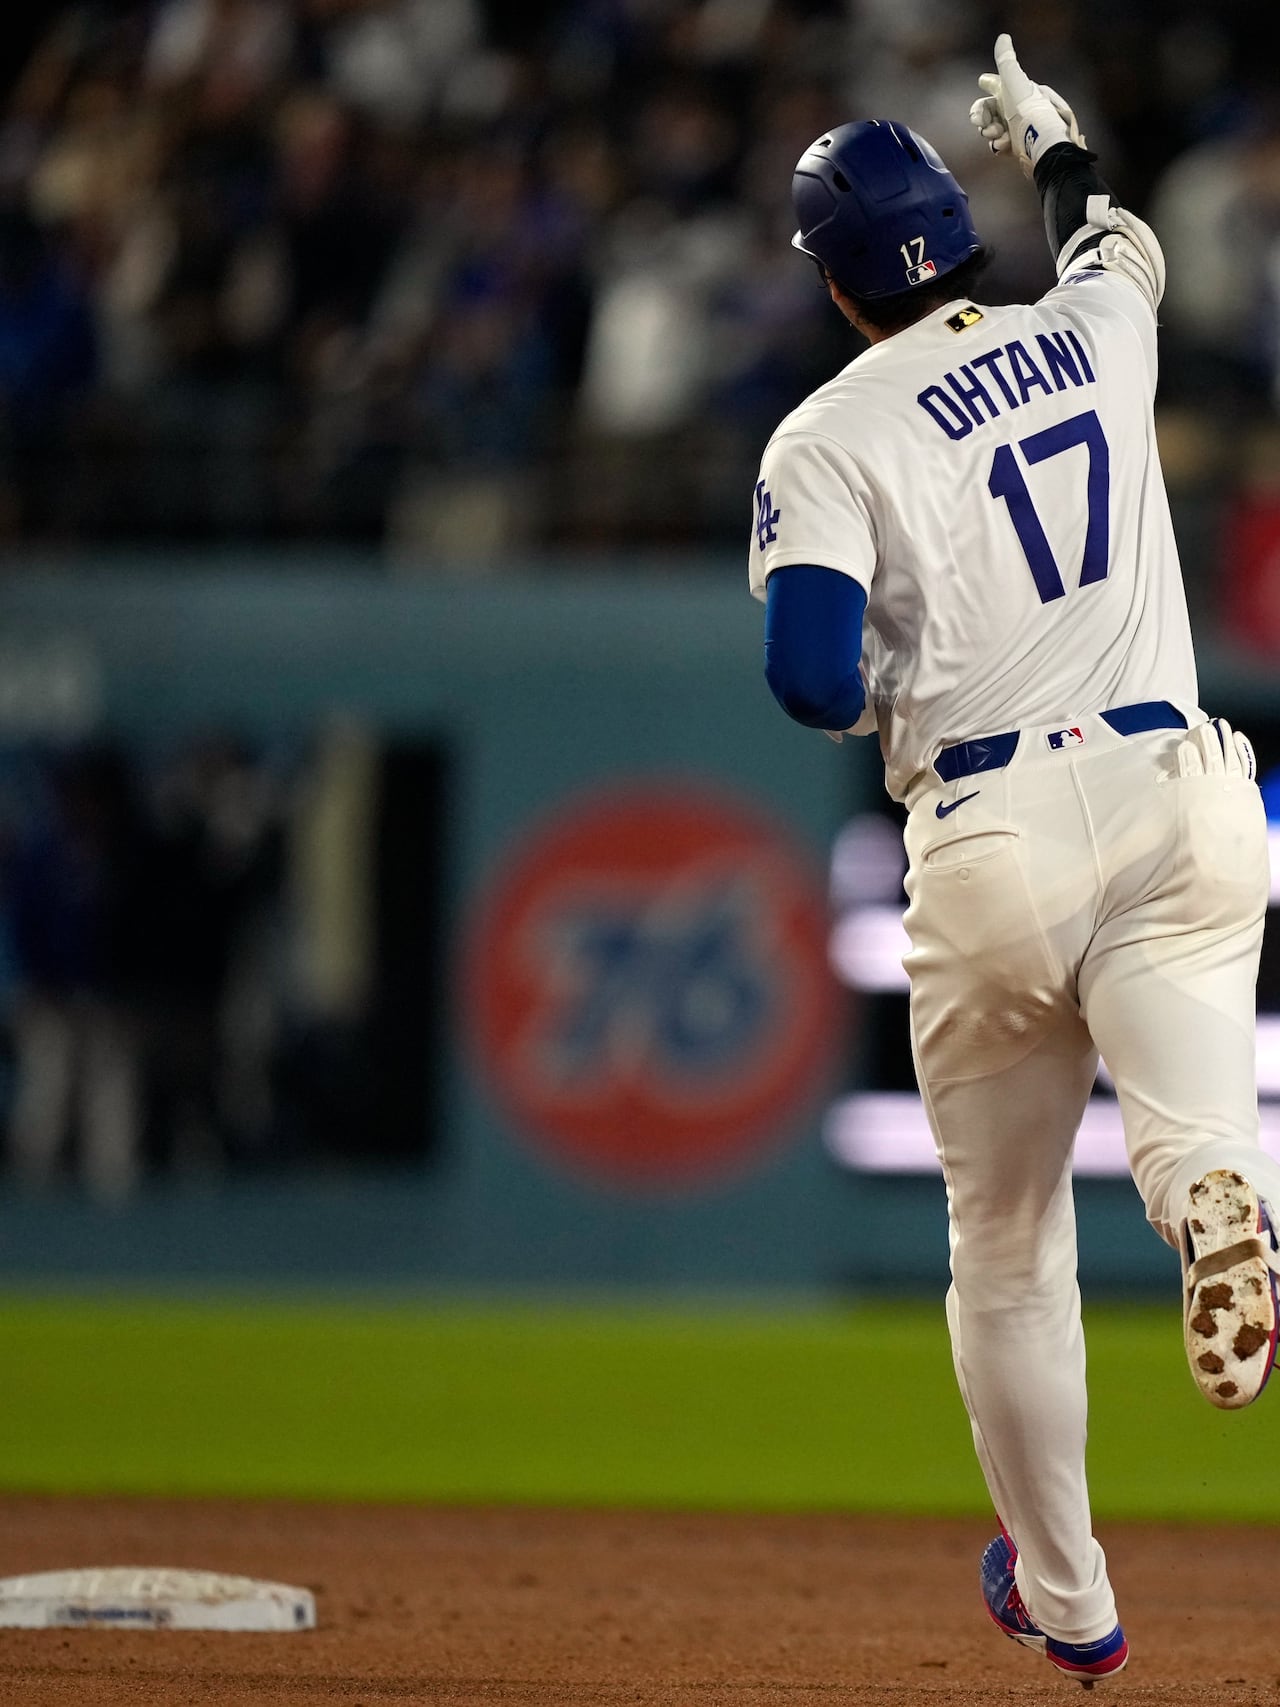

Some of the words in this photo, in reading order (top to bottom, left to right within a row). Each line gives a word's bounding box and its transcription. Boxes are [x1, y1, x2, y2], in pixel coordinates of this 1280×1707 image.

[900, 236, 925, 268] 17
[917, 330, 1096, 440] OHTANI
[988, 409, 1110, 604] 17
